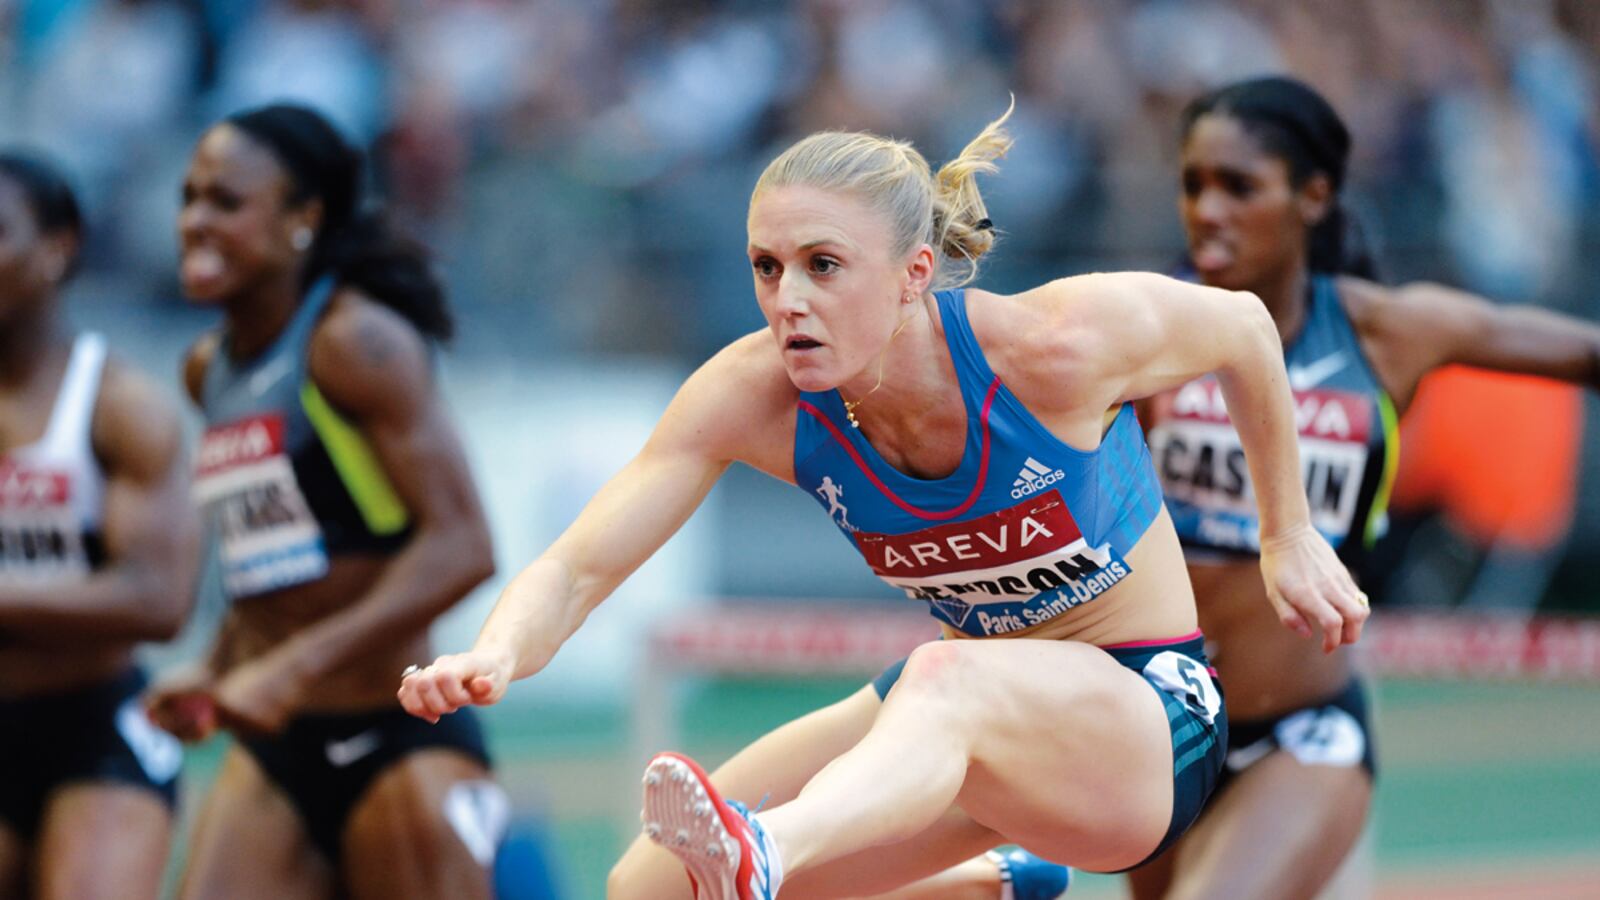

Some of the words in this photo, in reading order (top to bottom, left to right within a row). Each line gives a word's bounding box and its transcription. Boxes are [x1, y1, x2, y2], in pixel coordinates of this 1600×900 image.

[1173, 382, 1350, 438] ARVA
[1011, 469, 1065, 499] adidas
[1163, 438, 1349, 512] CASIN
[884, 515, 1053, 569] AREVA
[977, 608, 1026, 636] Paris
[1023, 560, 1127, 625] Saint-Denis
[1177, 657, 1210, 716] 5
